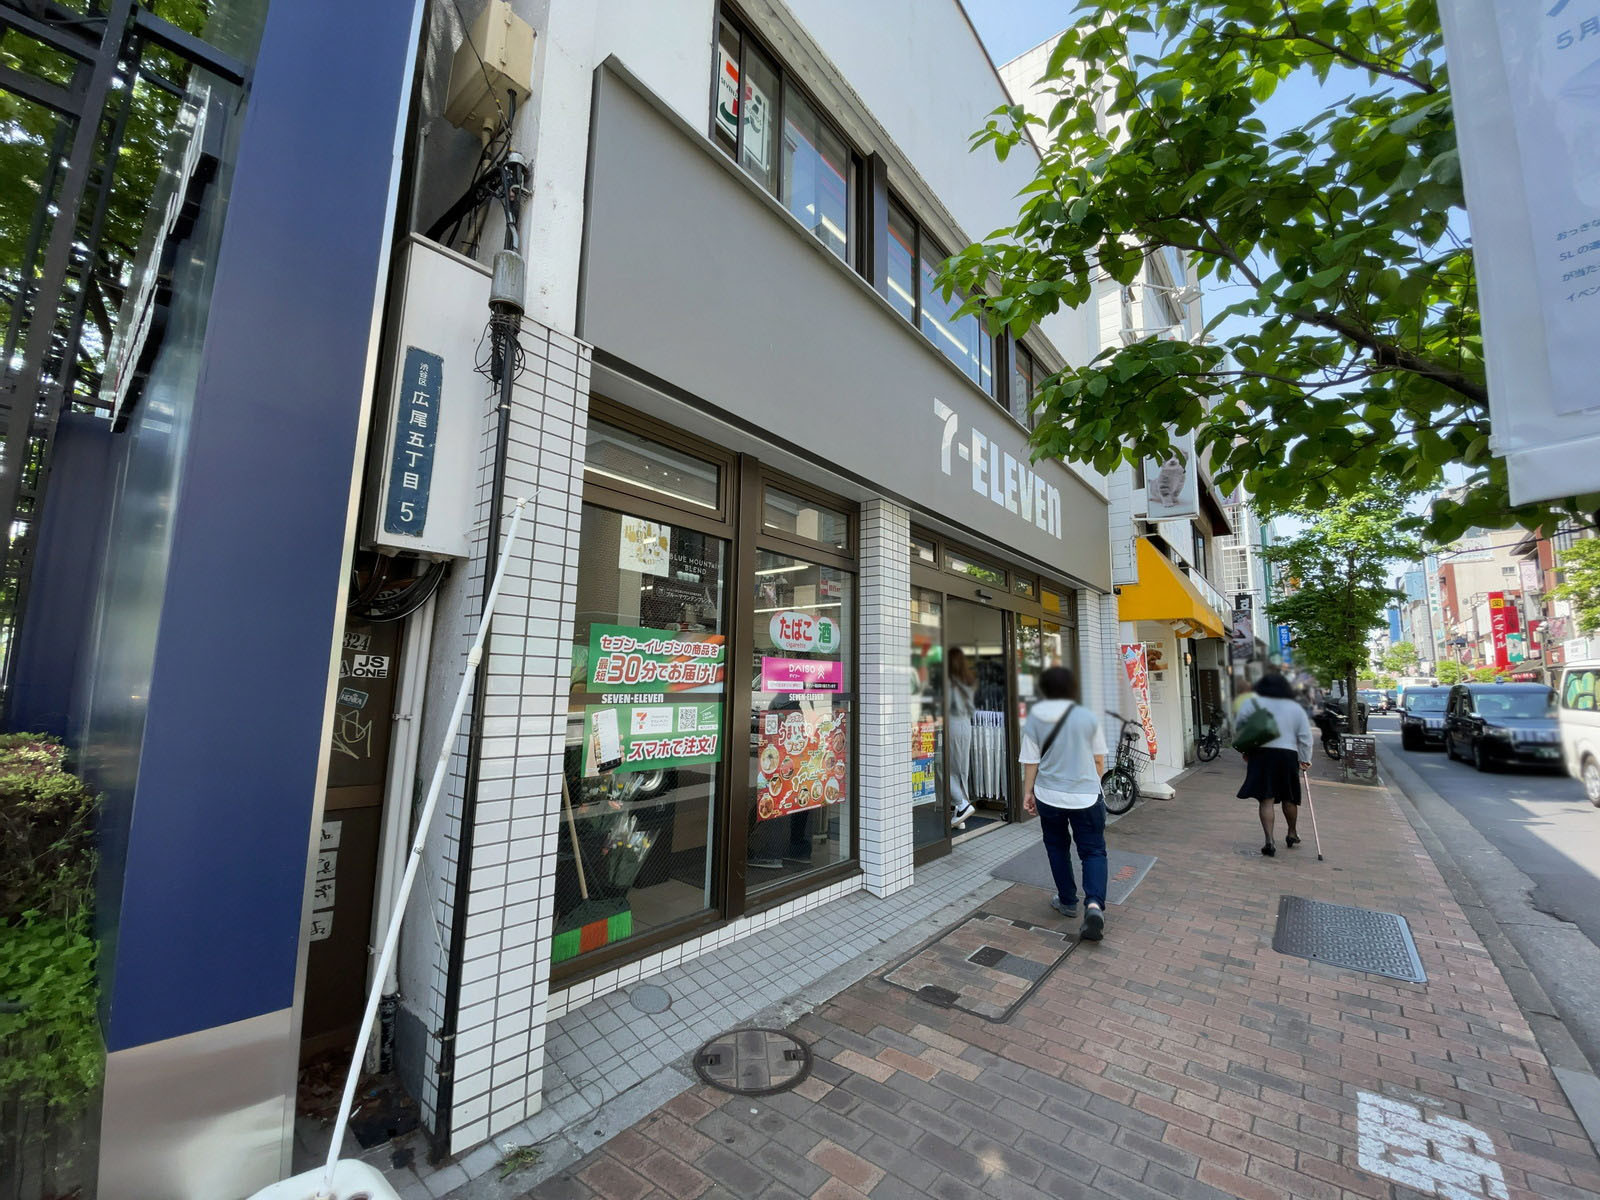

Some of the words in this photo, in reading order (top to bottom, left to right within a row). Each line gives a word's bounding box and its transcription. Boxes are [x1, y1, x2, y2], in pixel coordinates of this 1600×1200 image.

[418, 362, 429, 387] 渋谷区
[402, 391, 430, 490] 広尾五丁目
[400, 502, 415, 522] 5
[684, 565, 707, 575] BLEND
[779, 616, 813, 641] たばこ
[818, 621, 832, 644] 酒
[1493, 614, 1507, 649] スマイル
[359, 656, 384, 668] JS
[788, 664, 816, 673] DAISO
[353, 668, 386, 678] ONE
